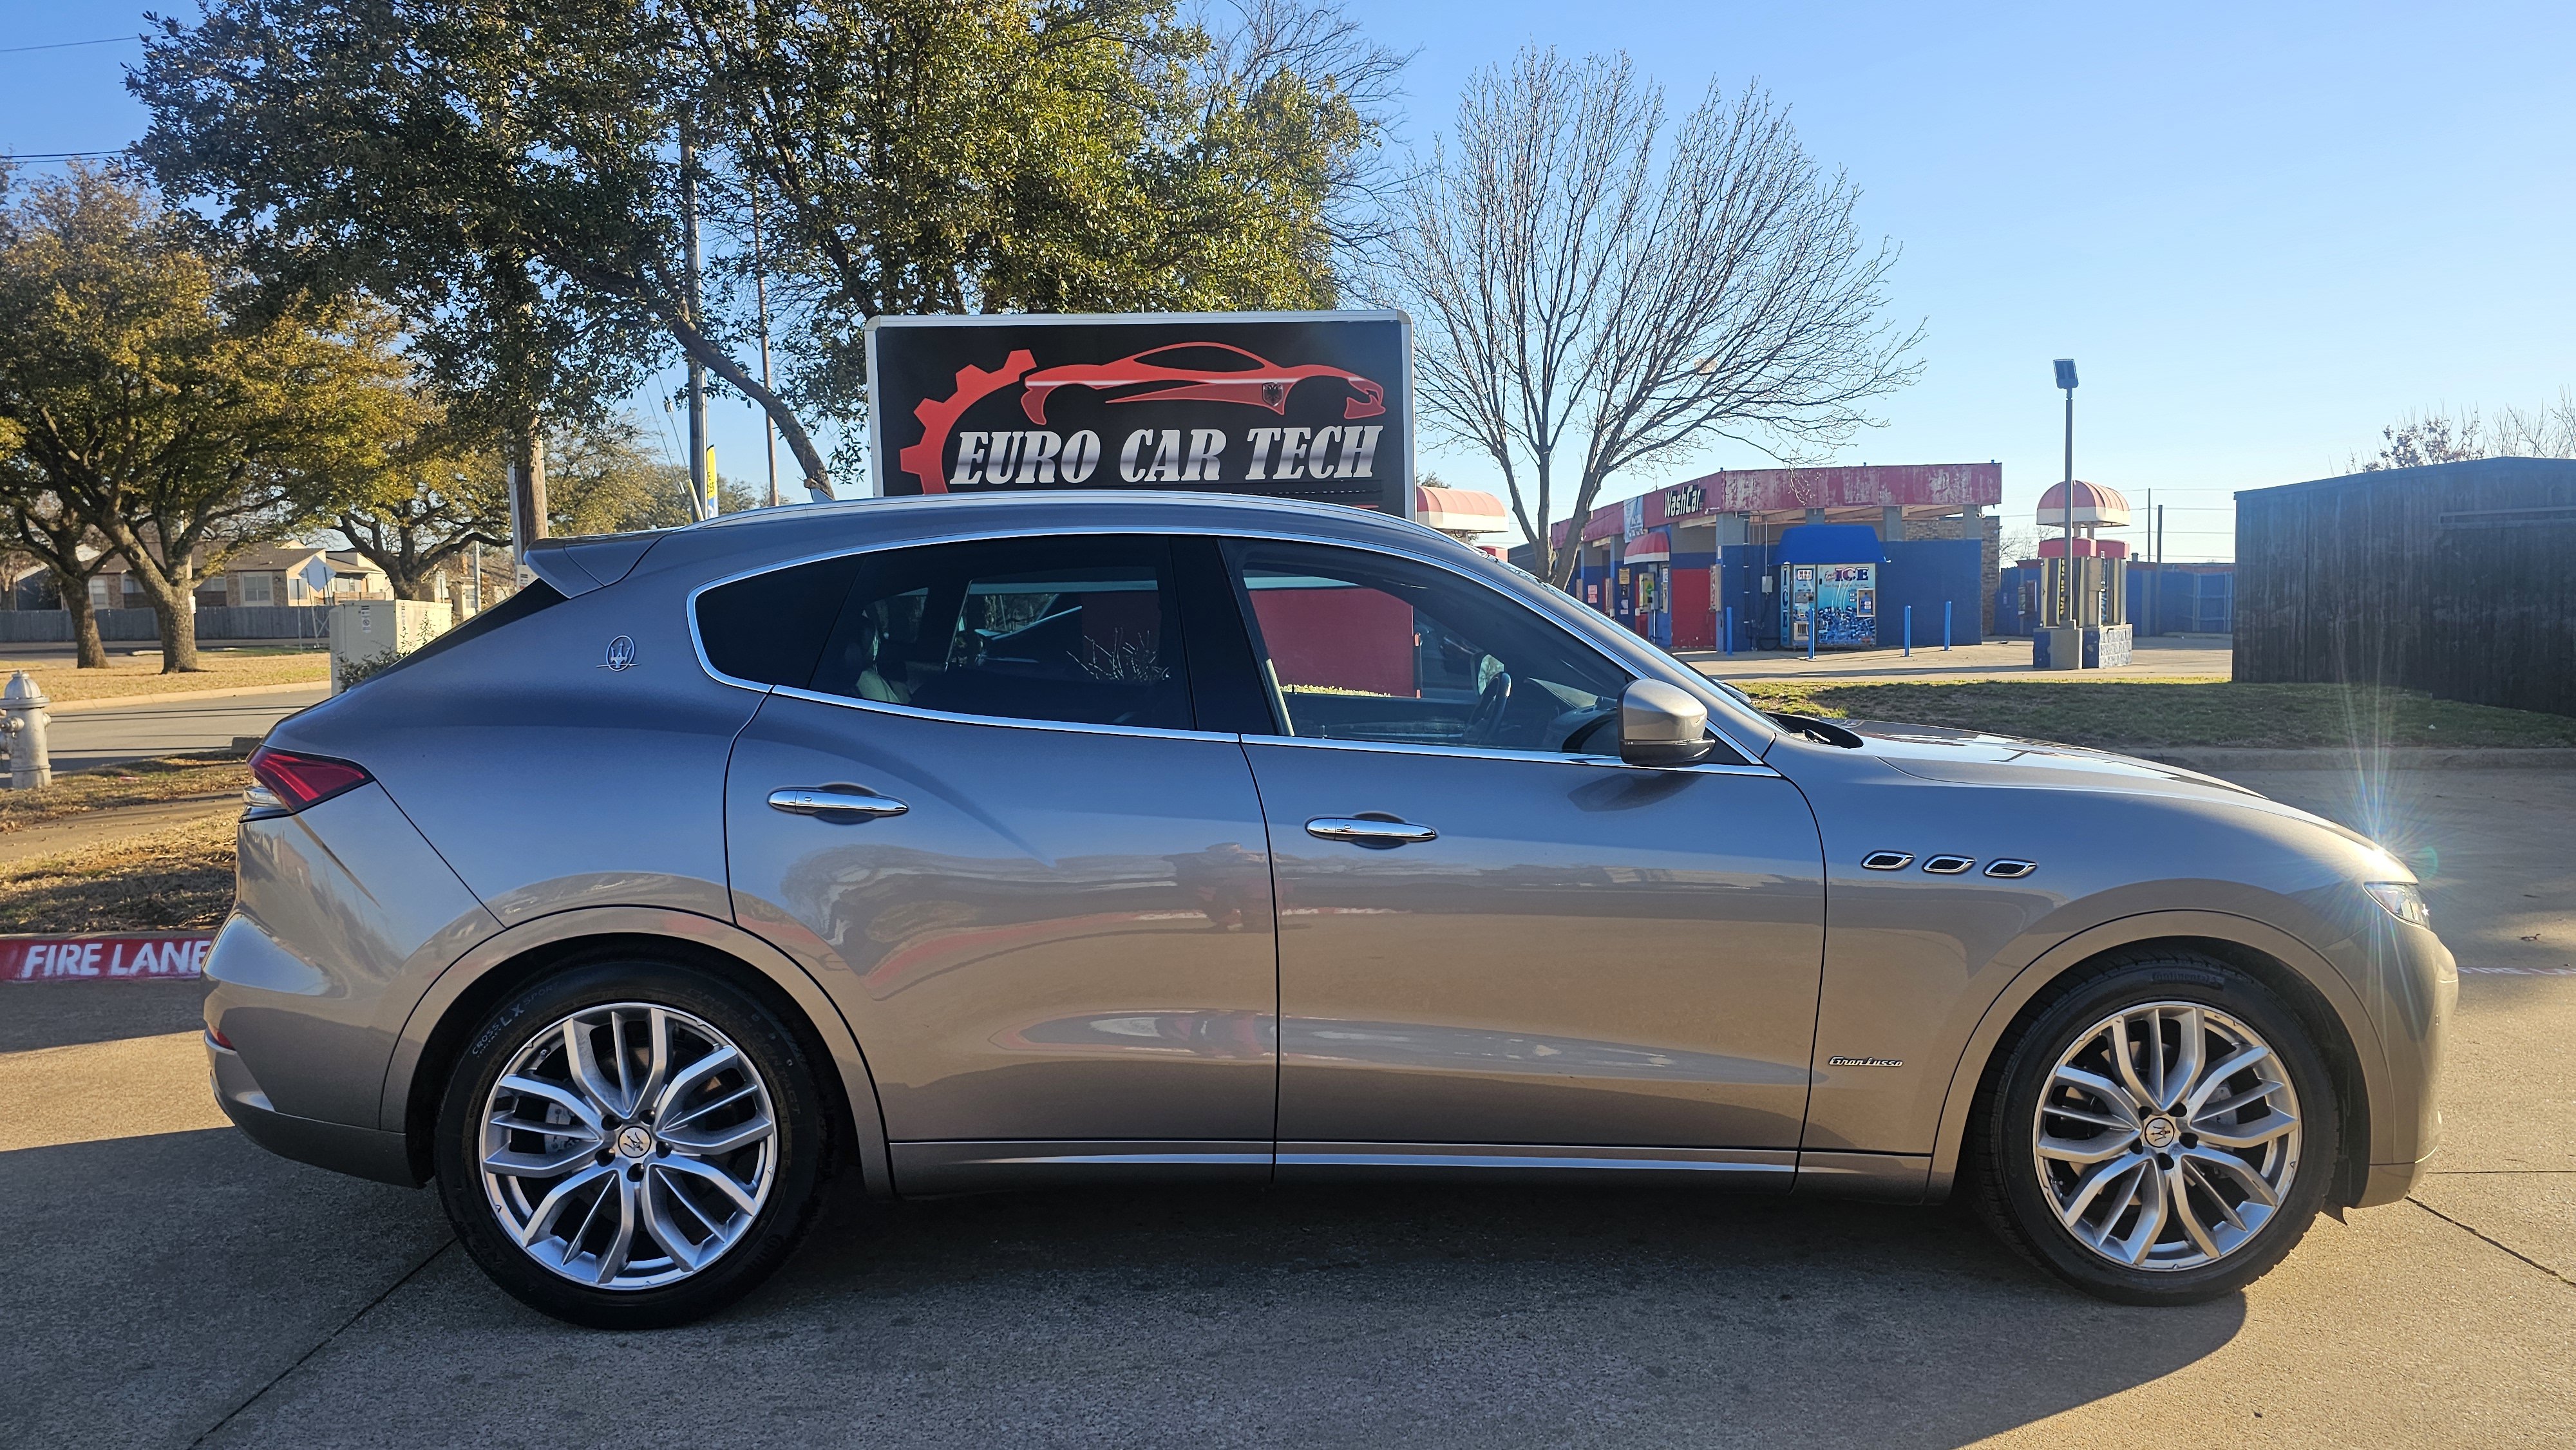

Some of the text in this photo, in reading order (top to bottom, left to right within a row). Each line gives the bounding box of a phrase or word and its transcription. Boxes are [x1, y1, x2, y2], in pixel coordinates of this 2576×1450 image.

[949, 426, 1383, 484] EURO CAR TECH
[1664, 485, 1701, 518] WashCar
[1834, 567, 1869, 581] ICE
[21, 941, 211, 978] FIRE LANE
[472, 1022, 499, 1055] CROSS
